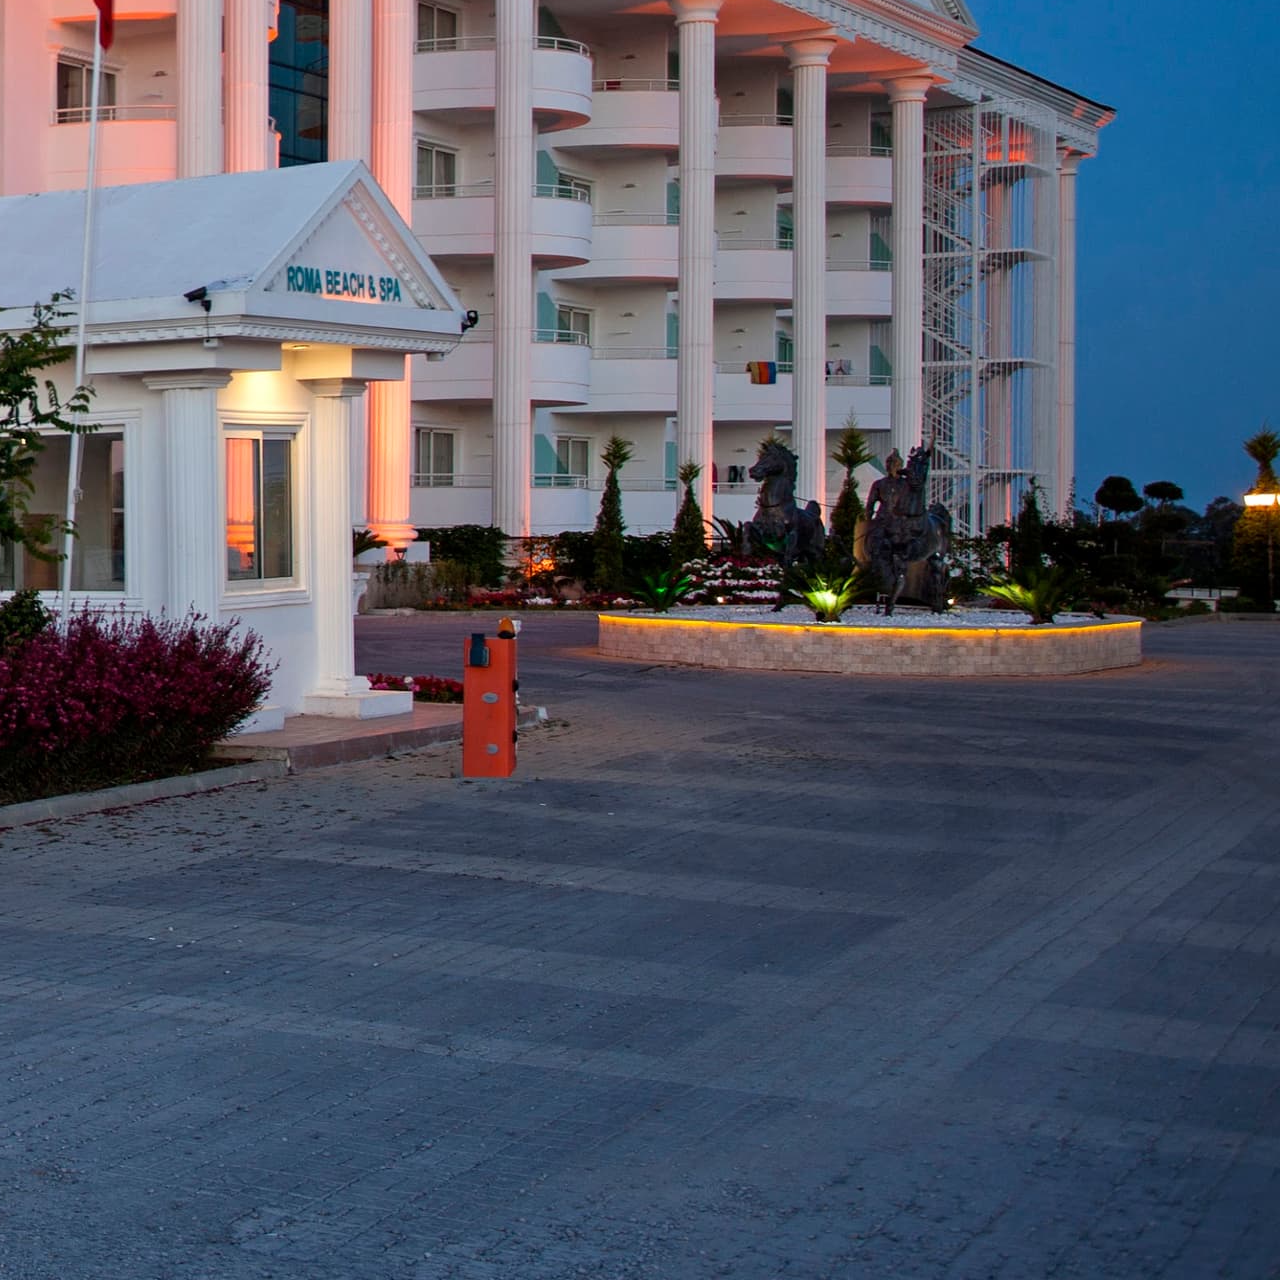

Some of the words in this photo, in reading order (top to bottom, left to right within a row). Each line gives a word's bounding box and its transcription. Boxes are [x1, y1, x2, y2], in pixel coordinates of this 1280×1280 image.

[286, 265, 322, 294] ROMA
[325, 270, 366, 298] BEACH
[368, 275, 377, 299] &
[379, 277, 402, 302] SPA
